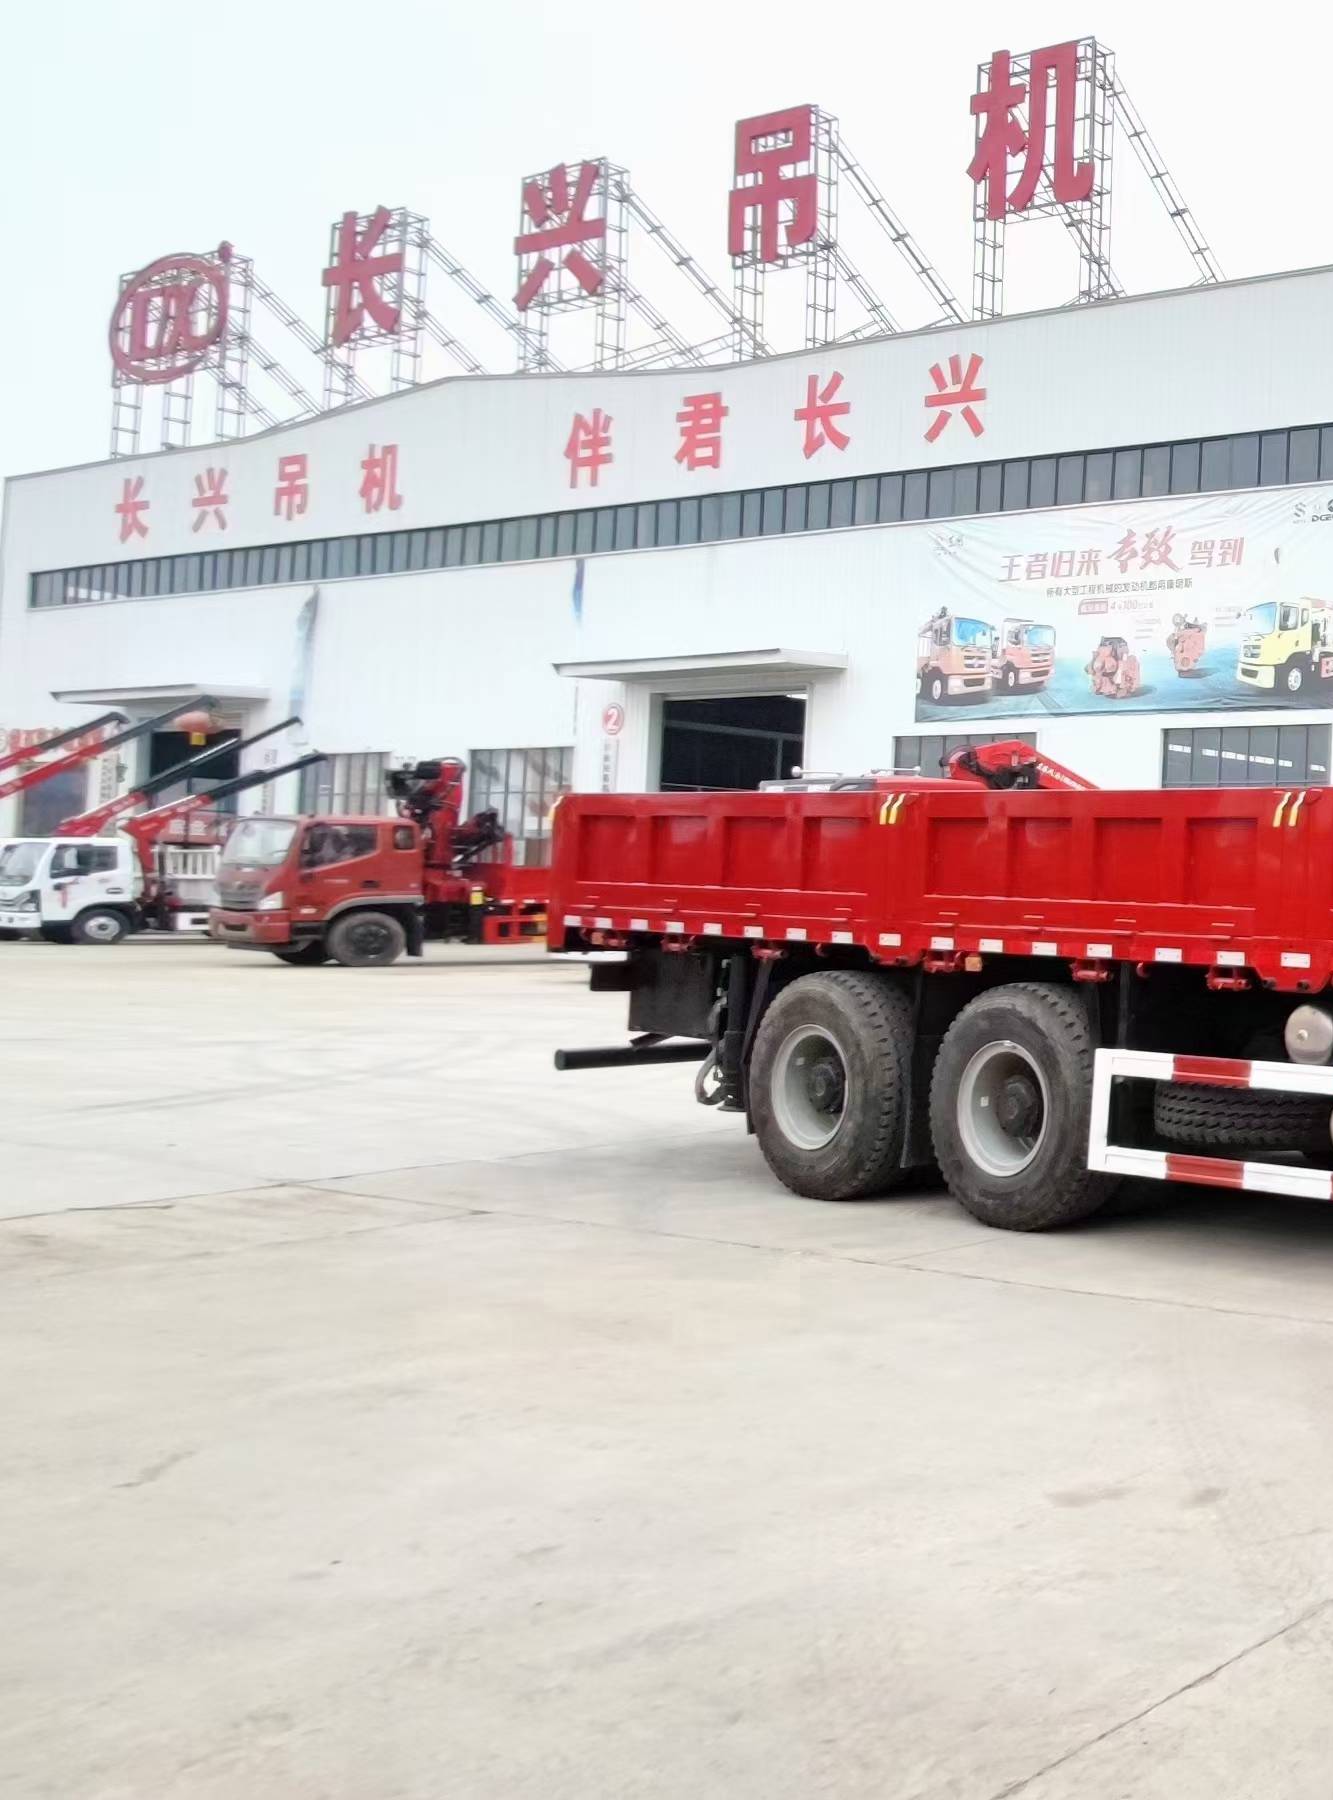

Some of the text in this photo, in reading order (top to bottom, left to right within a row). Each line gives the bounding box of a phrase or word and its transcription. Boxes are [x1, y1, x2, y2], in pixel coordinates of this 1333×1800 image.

[321, 41, 1096, 348] 长兴吊机
[115, 352, 987, 543] 长兴吊机 伴君长兴
[606, 707, 619, 731] 2
